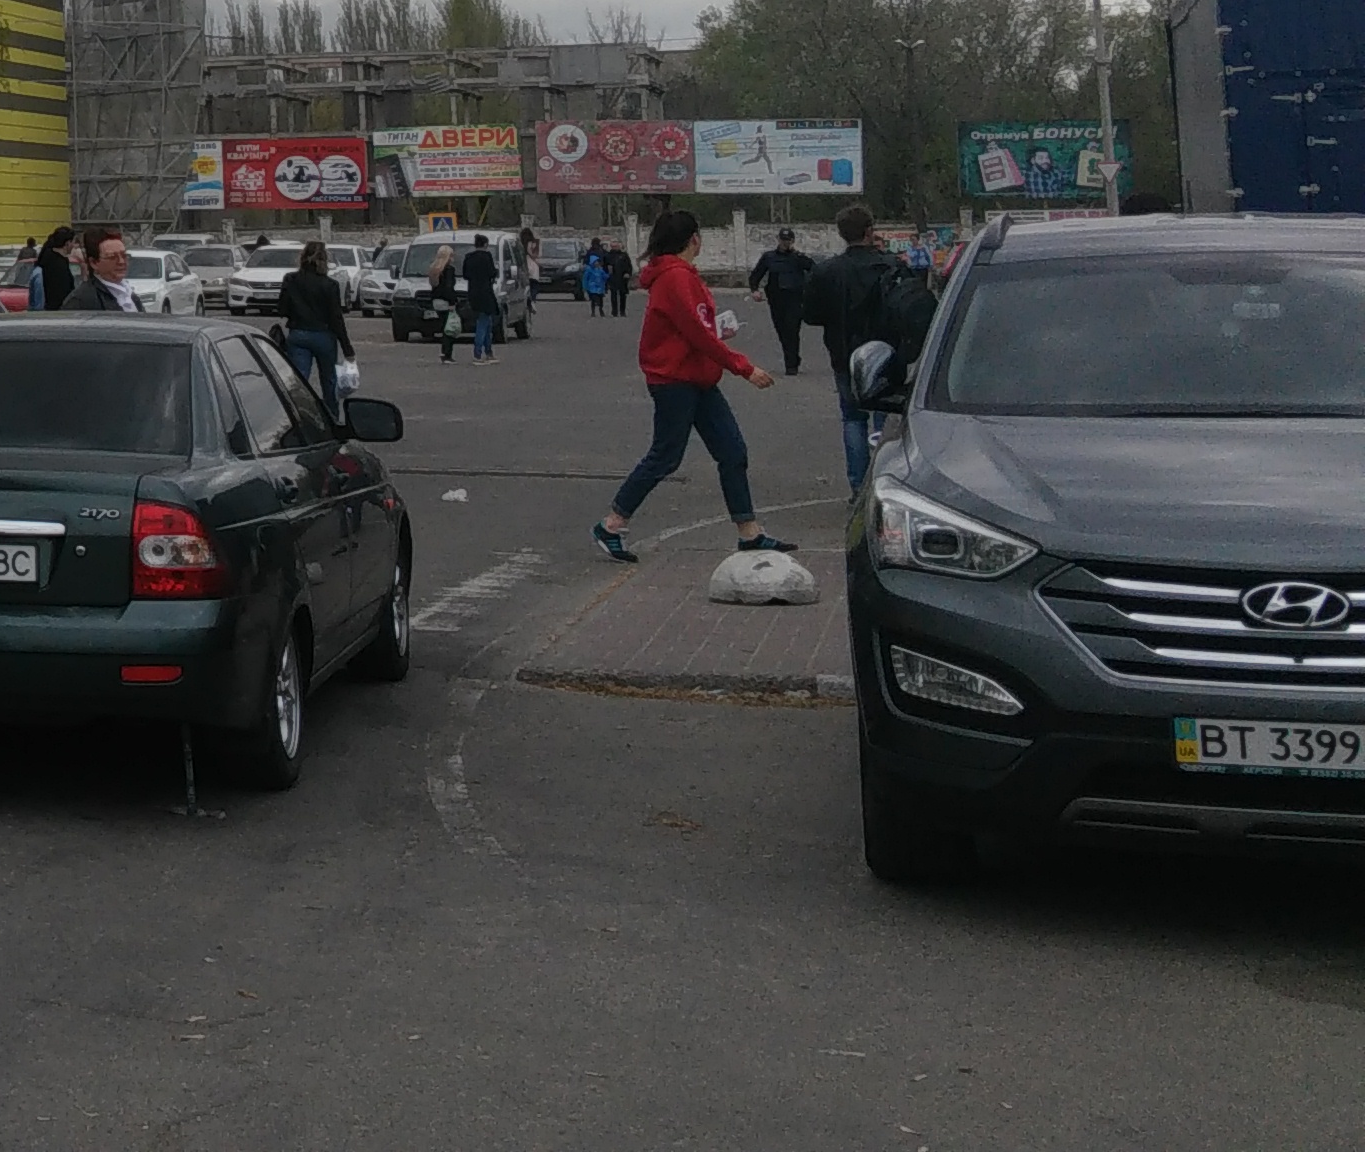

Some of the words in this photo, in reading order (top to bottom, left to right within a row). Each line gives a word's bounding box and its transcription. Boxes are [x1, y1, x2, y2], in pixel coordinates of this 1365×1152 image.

[387, 132, 419, 142] ТИТАН
[418, 127, 516, 148] ДВЕРИ
[970, 130, 1030, 142] Отримуй
[78, 507, 121, 520] 2170
[1199, 724, 1256, 759] BT
[1268, 727, 1361, 764] 3399
[1179, 746, 1197, 757] UA
